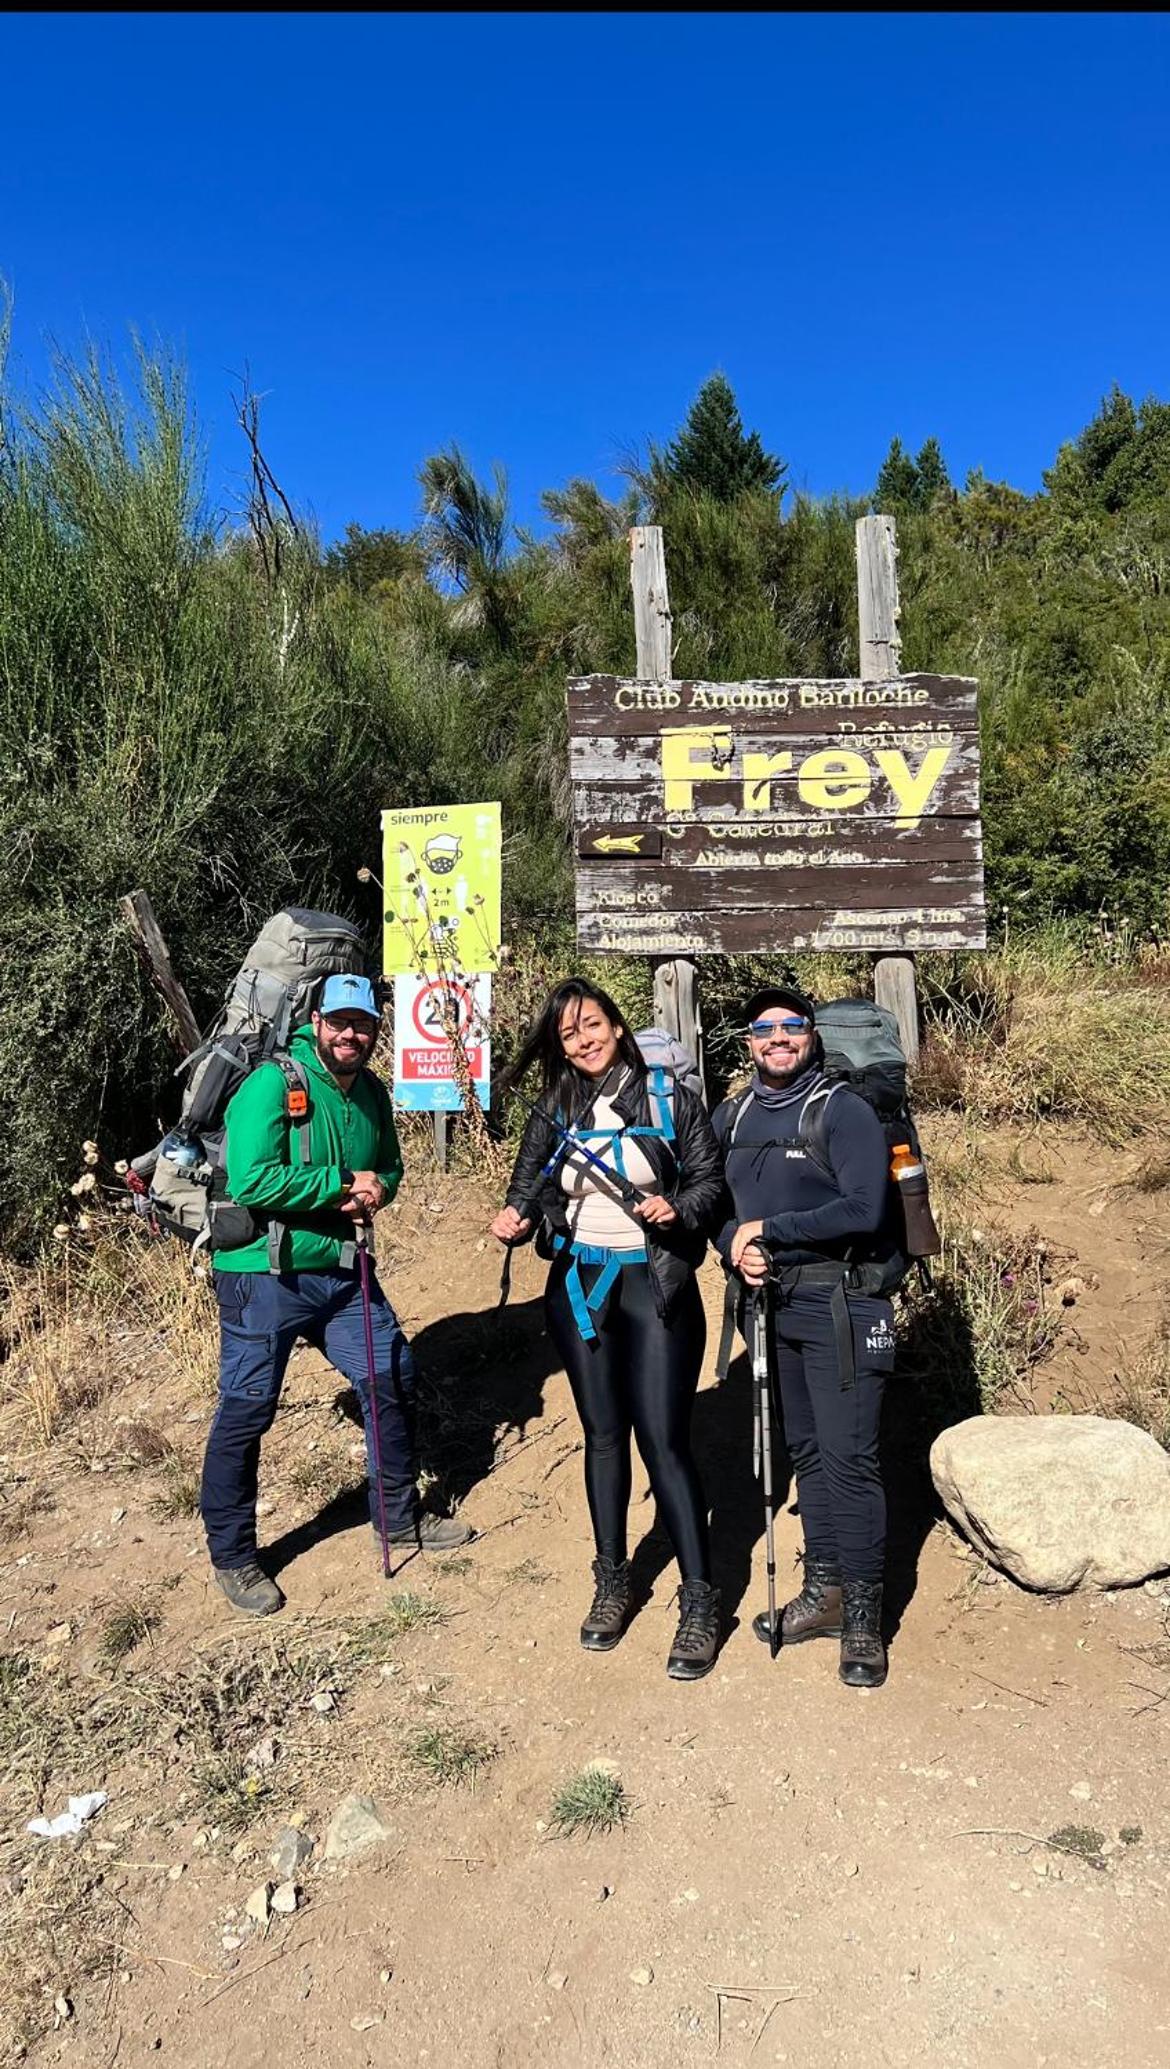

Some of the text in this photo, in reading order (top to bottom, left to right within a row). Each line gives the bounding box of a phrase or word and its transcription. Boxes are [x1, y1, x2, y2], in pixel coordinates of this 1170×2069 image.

[615, 685, 929, 710] Club Andino Bariloche
[838, 721, 953, 750] Refugio
[660, 725, 952, 829] Frey
[391, 811, 449, 826] siempre
[708, 812, 835, 838] Catedral
[599, 891, 660, 905] Kiosco
[600, 913, 680, 930] Comedor
[600, 933, 705, 950] Alojamiento
